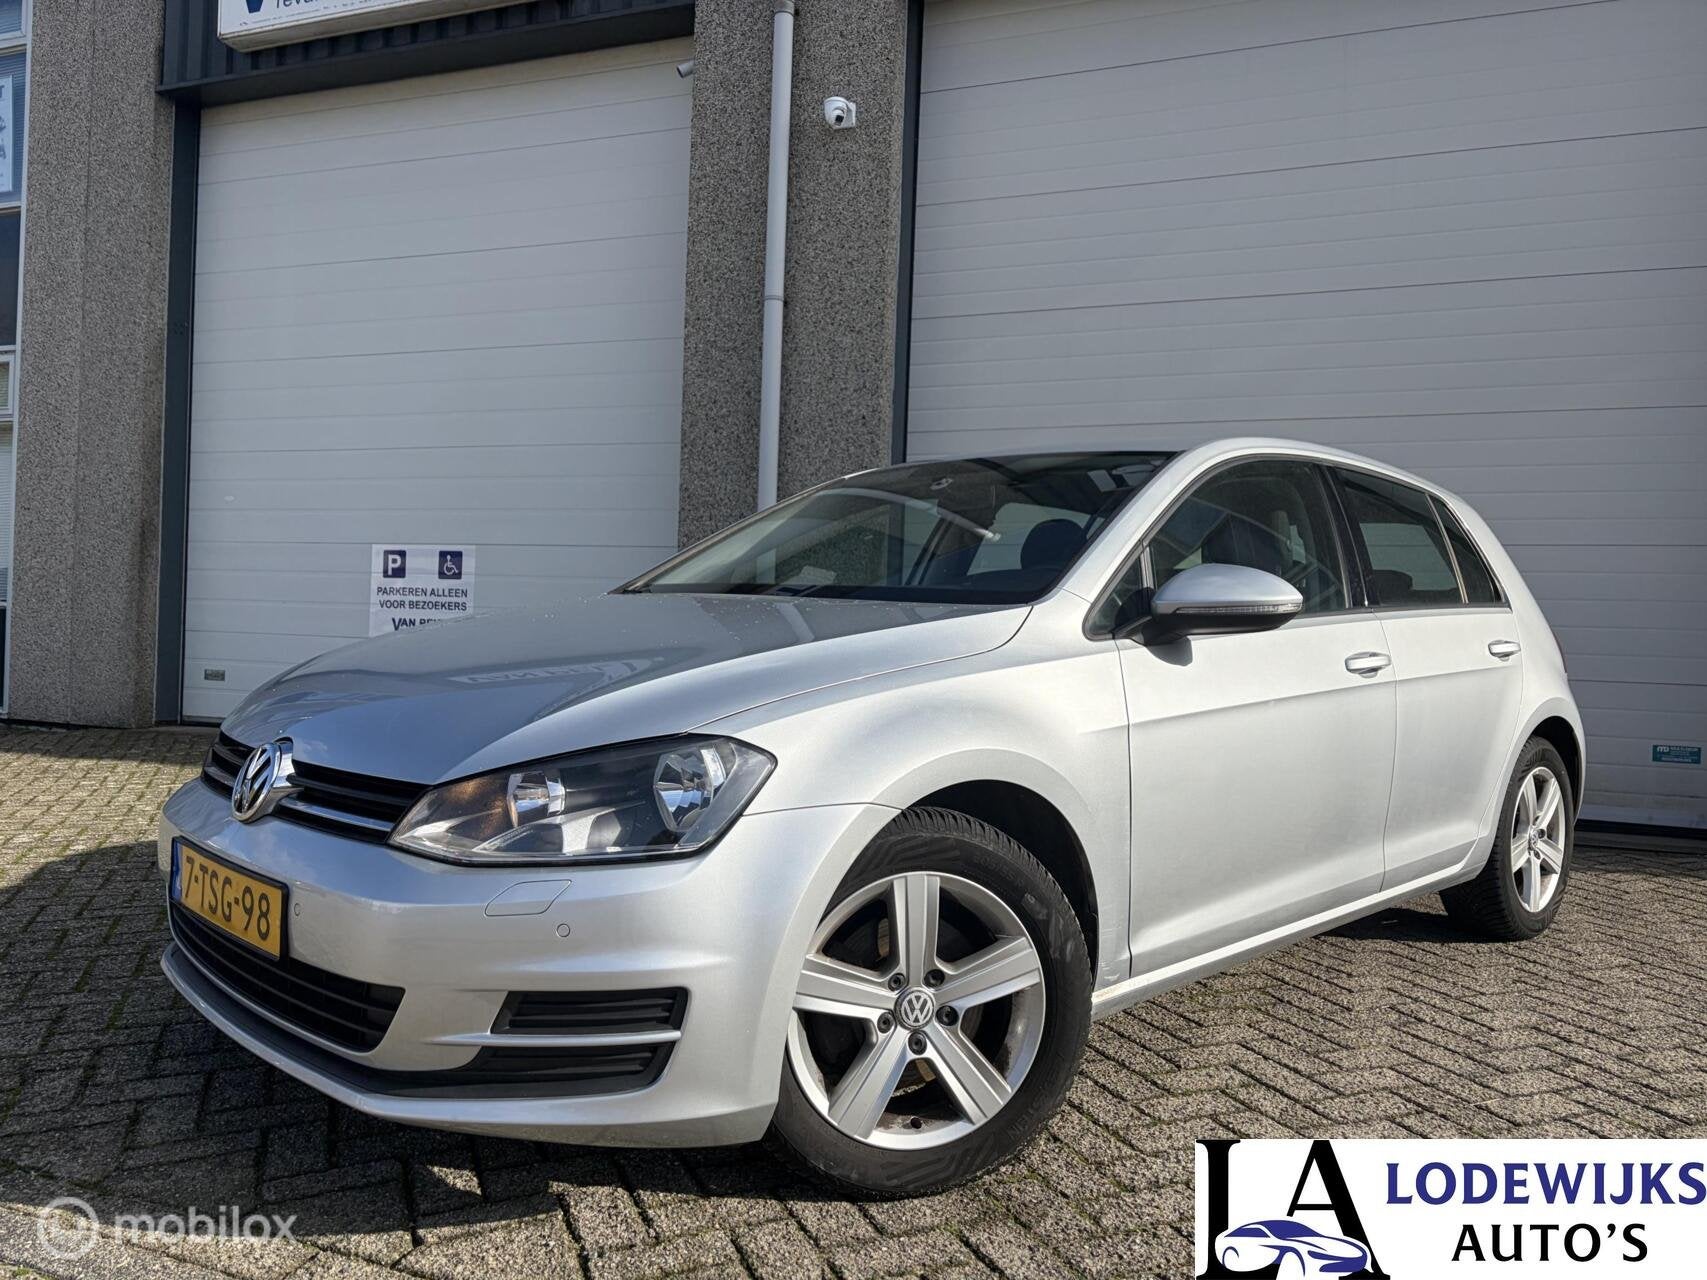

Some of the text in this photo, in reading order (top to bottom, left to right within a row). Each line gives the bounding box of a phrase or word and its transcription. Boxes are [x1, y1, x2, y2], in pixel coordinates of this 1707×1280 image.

[387, 554, 402, 576] P
[376, 586, 468, 598] PARKEREN ALLEEN
[379, 600, 468, 612] VOOR BEZOEKERS
[392, 617, 416, 631] VAN
[185, 855, 271, 941] 7-TSG-98
